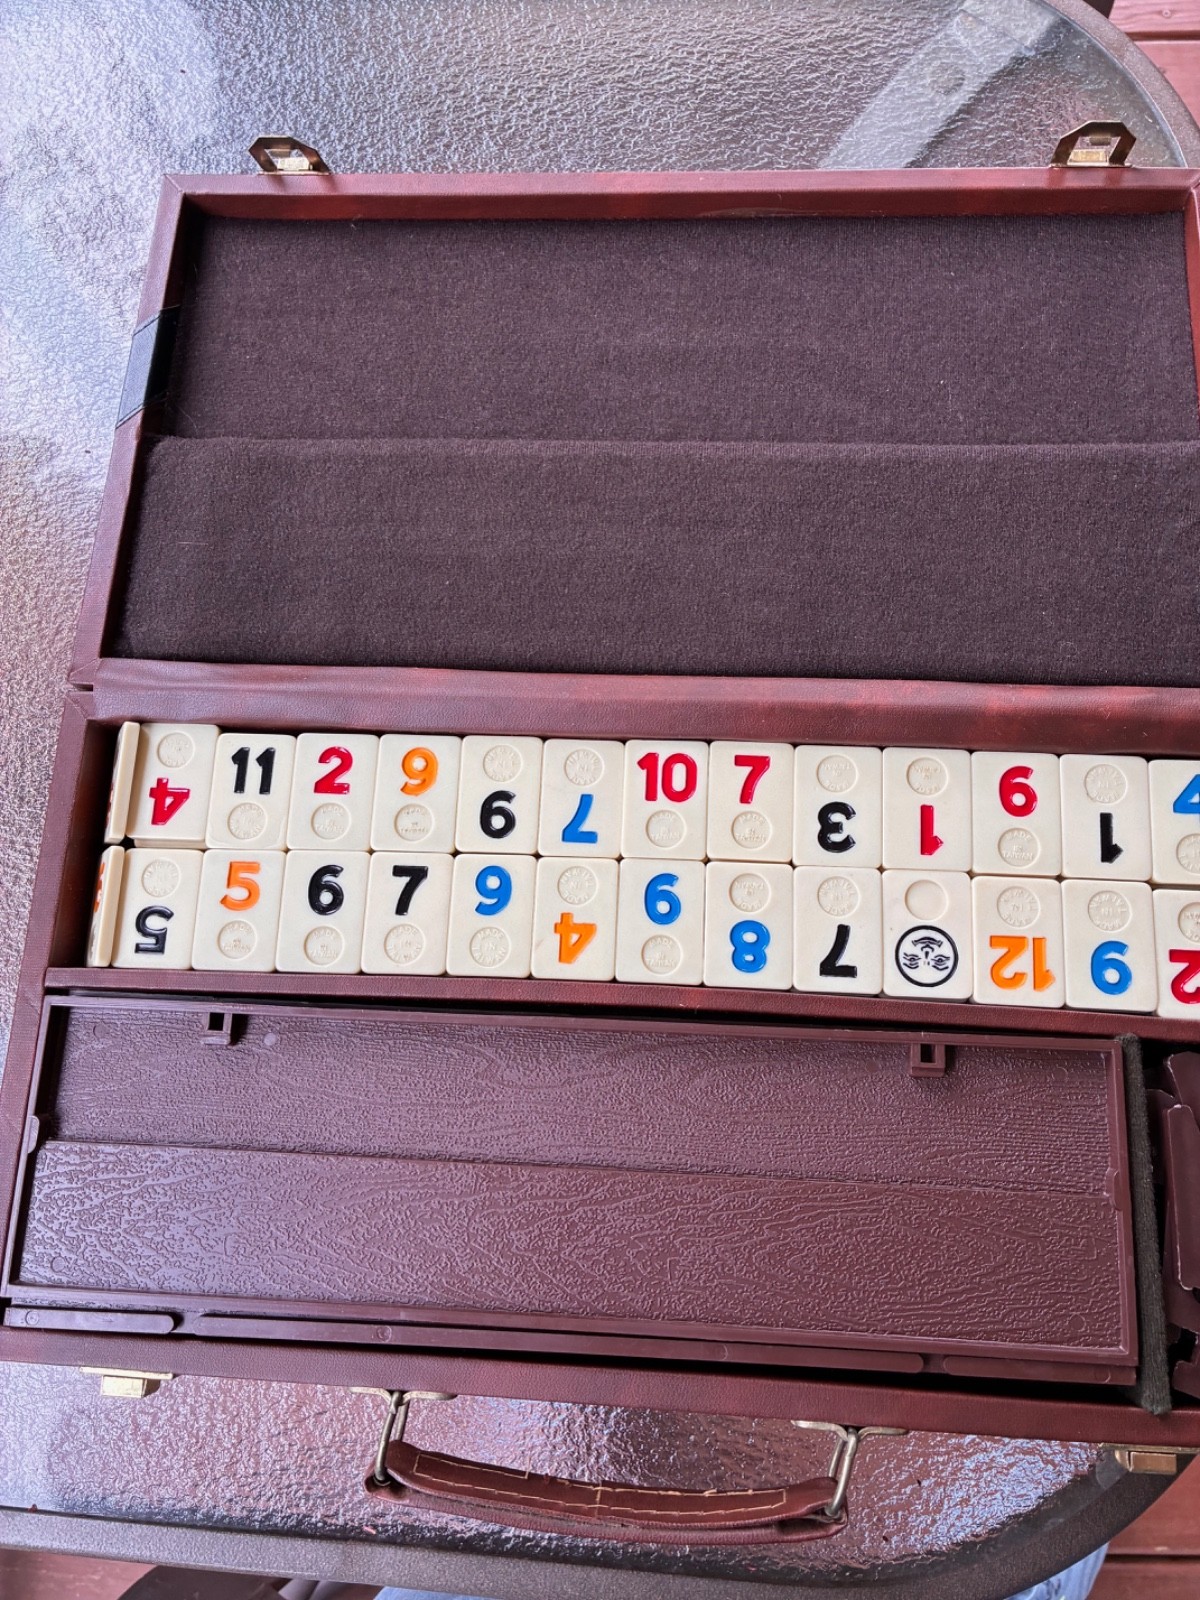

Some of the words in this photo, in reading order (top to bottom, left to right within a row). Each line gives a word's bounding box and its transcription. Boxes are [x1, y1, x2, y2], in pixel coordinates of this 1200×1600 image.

[231, 747, 276, 795] 11
[313, 746, 354, 795] 2
[400, 747, 439, 797] 9
[636, 751, 698, 804] 10
[733, 754, 771, 805] 7
[998, 765, 1038, 818] 6
[149, 777, 191, 826] 4
[561, 793, 598, 844] 7
[1172, 773, 1200, 825] 4
[817, 801, 857, 854] 3
[919, 804, 944, 856] 1
[1099, 812, 1123, 864] 1
[219, 860, 261, 911] 5
[307, 864, 345, 916] 6
[392, 865, 429, 916] 7
[474, 865, 513, 917] 9
[644, 872, 682, 926] 6
[134, 906, 174, 954] 5
[554, 912, 597, 964] 4
[729, 919, 771, 974] 8
[819, 923, 858, 979] 7
[988, 934, 1056, 992] 12
